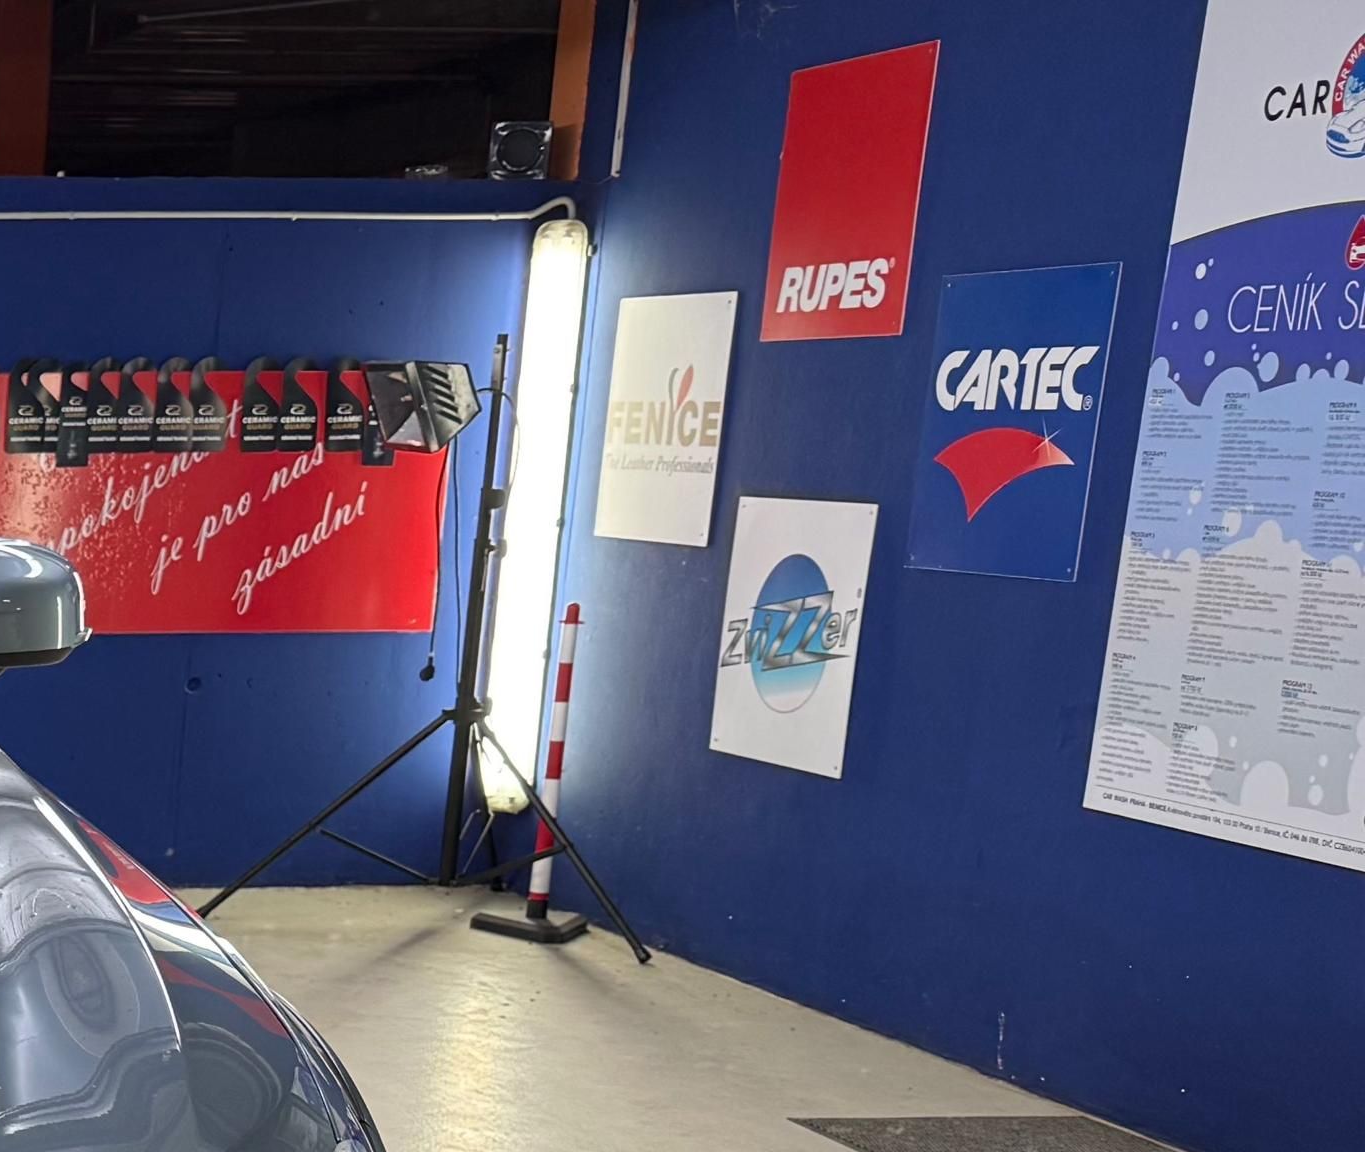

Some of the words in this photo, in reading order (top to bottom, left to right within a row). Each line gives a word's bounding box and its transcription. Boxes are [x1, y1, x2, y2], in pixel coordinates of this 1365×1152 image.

[1334, 67, 1351, 102] CAR
[1264, 80, 1331, 122] CAR
[775, 257, 889, 313] RUPES
[1227, 272, 1327, 333] CENÍK
[8, 417, 44, 425] CERAMIC
[118, 417, 153, 425] CERAMIC
[155, 417, 191, 425] CERAMIC
[242, 416, 278, 424] CERAMIC
[280, 416, 316, 424] CERAMIC
[327, 415, 363, 423] CERAMIC
[150, 534, 184, 596] je
[192, 491, 252, 562] pro
[231, 481, 369, 616] zásadní
